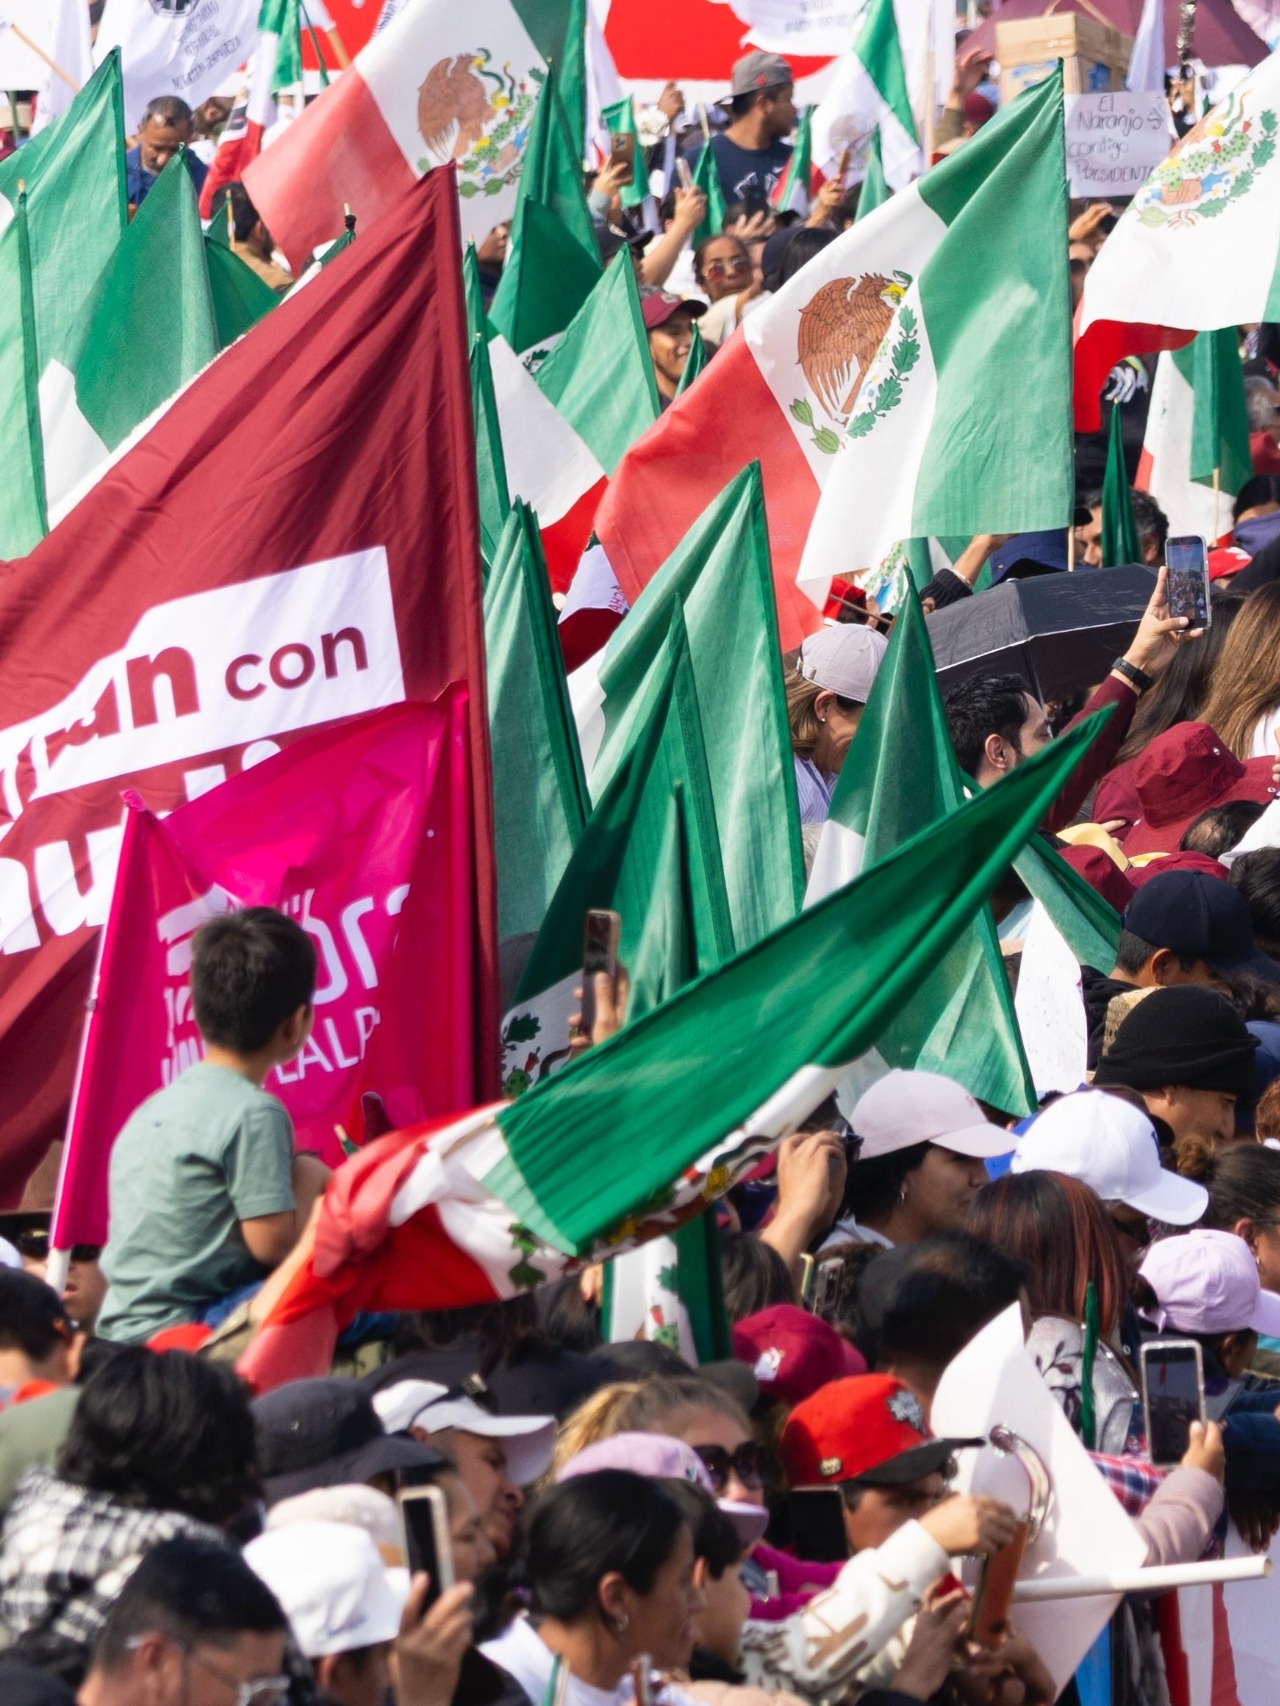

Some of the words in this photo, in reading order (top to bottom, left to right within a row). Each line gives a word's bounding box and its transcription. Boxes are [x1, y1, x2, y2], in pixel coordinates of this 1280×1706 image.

[1098, 93, 1115, 113] El
[1078, 108, 1143, 137] Naranjo
[1067, 137, 1129, 161] contigo
[224, 625, 369, 703] con
